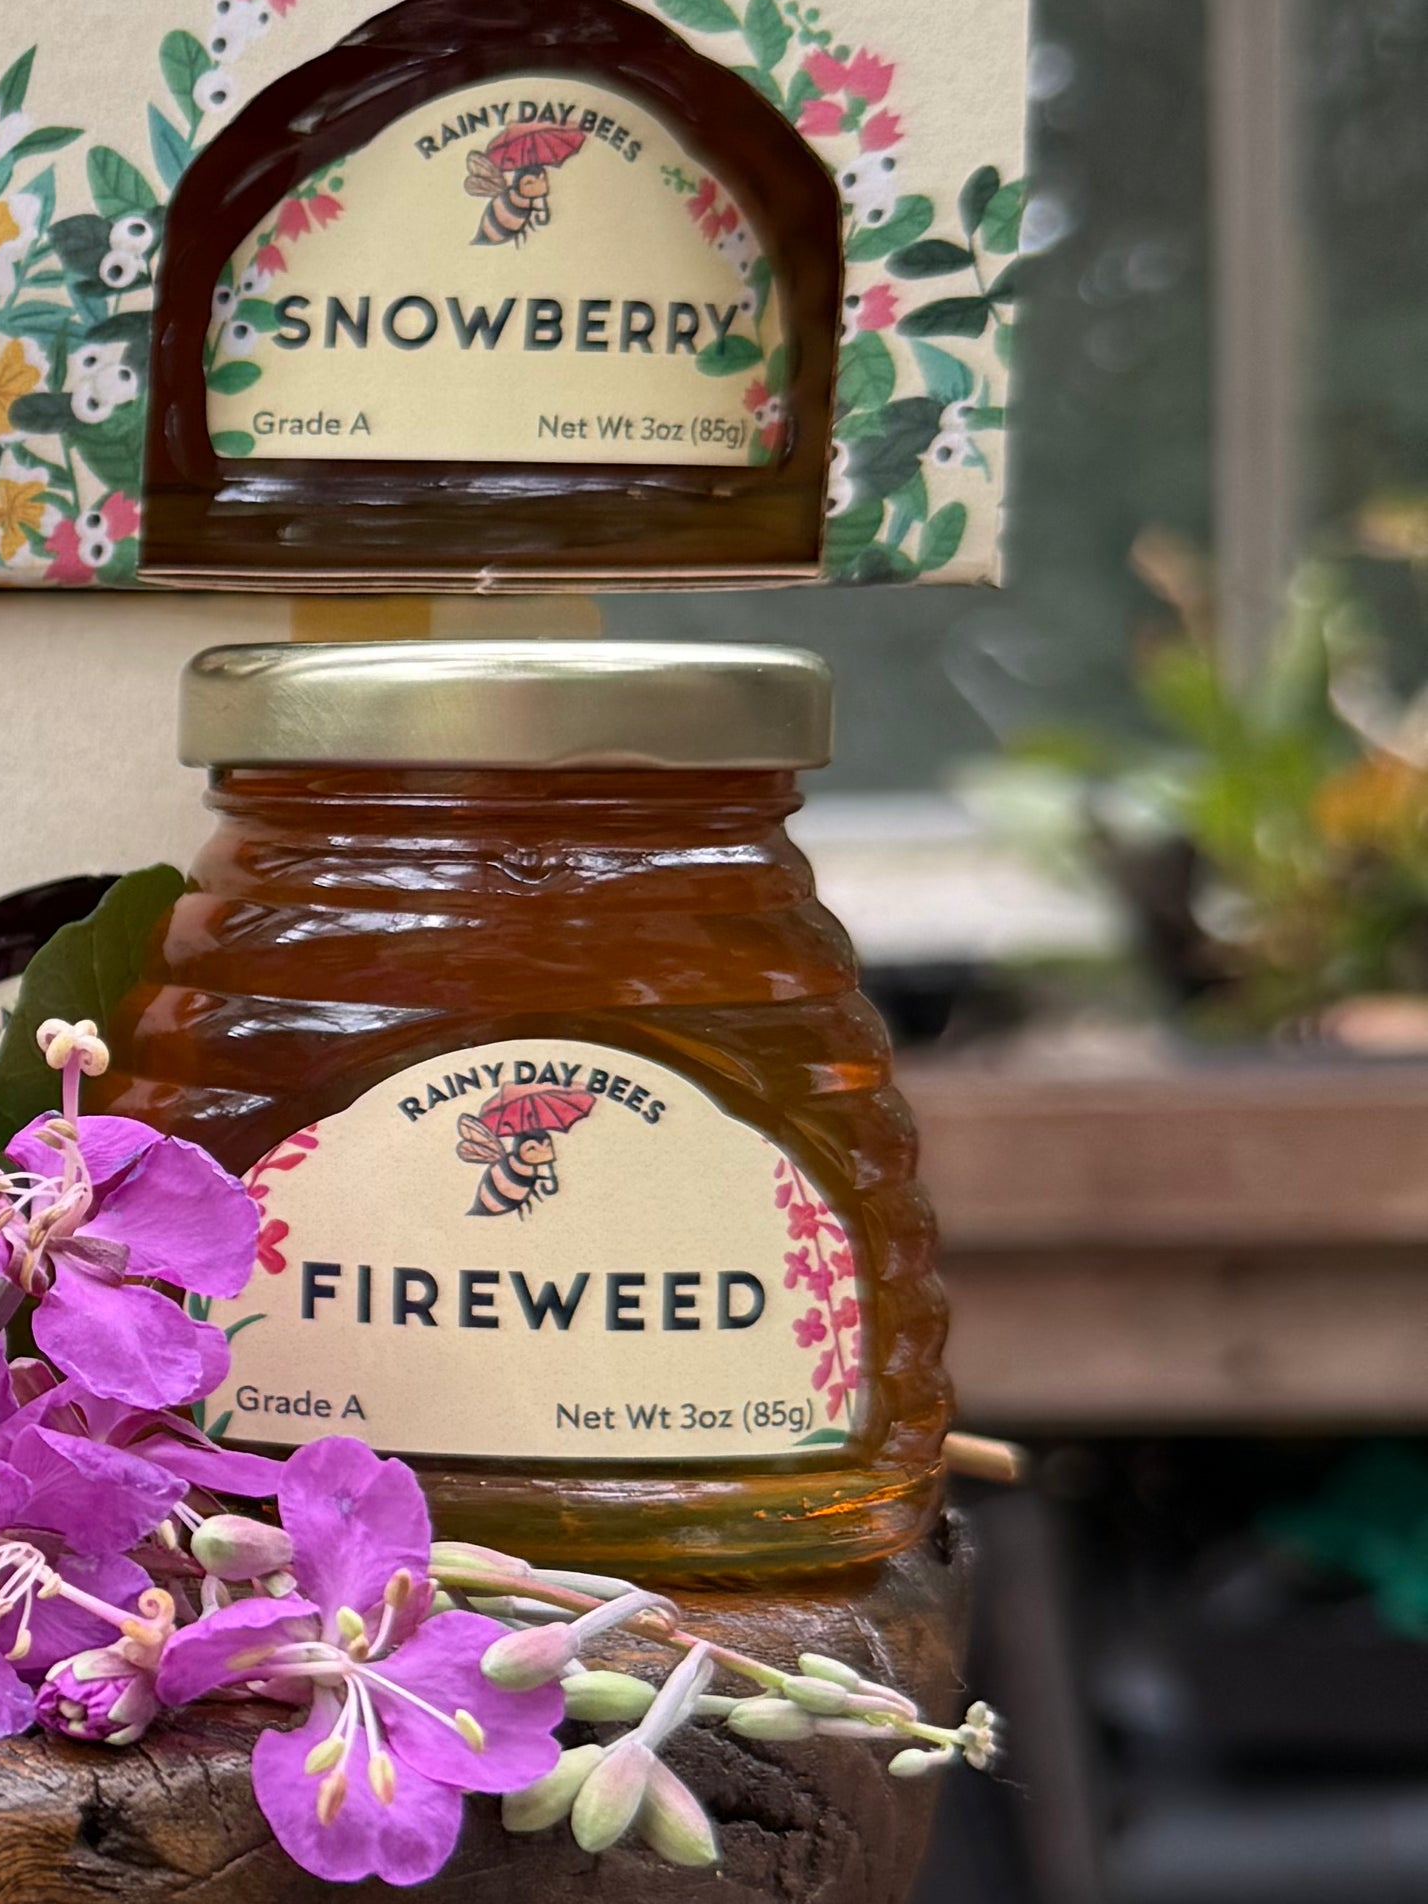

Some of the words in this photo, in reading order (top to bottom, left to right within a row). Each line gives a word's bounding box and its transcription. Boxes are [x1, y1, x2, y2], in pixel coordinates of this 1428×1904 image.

[415, 101, 511, 159] RAINY
[518, 101, 576, 126] DAY
[580, 108, 642, 162] BEES
[271, 295, 738, 356] SNOWBERRY
[252, 410, 341, 436] Grade
[349, 410, 371, 436] A
[537, 414, 588, 440] Net
[595, 415, 634, 441] Wt
[640, 416, 684, 441] 3oz
[690, 416, 747, 449] (85g)
[398, 1061, 504, 1122] RAINY
[513, 1060, 583, 1088] DAY
[586, 1068, 666, 1125] BEES
[300, 1260, 766, 1332] FIREWEED
[236, 1385, 332, 1418] Grade
[340, 1394, 366, 1420] A
[555, 1403, 615, 1430] Net
[625, 1403, 671, 1430] Wt
[679, 1403, 733, 1430] 3oz
[742, 1397, 813, 1434] (85g)
